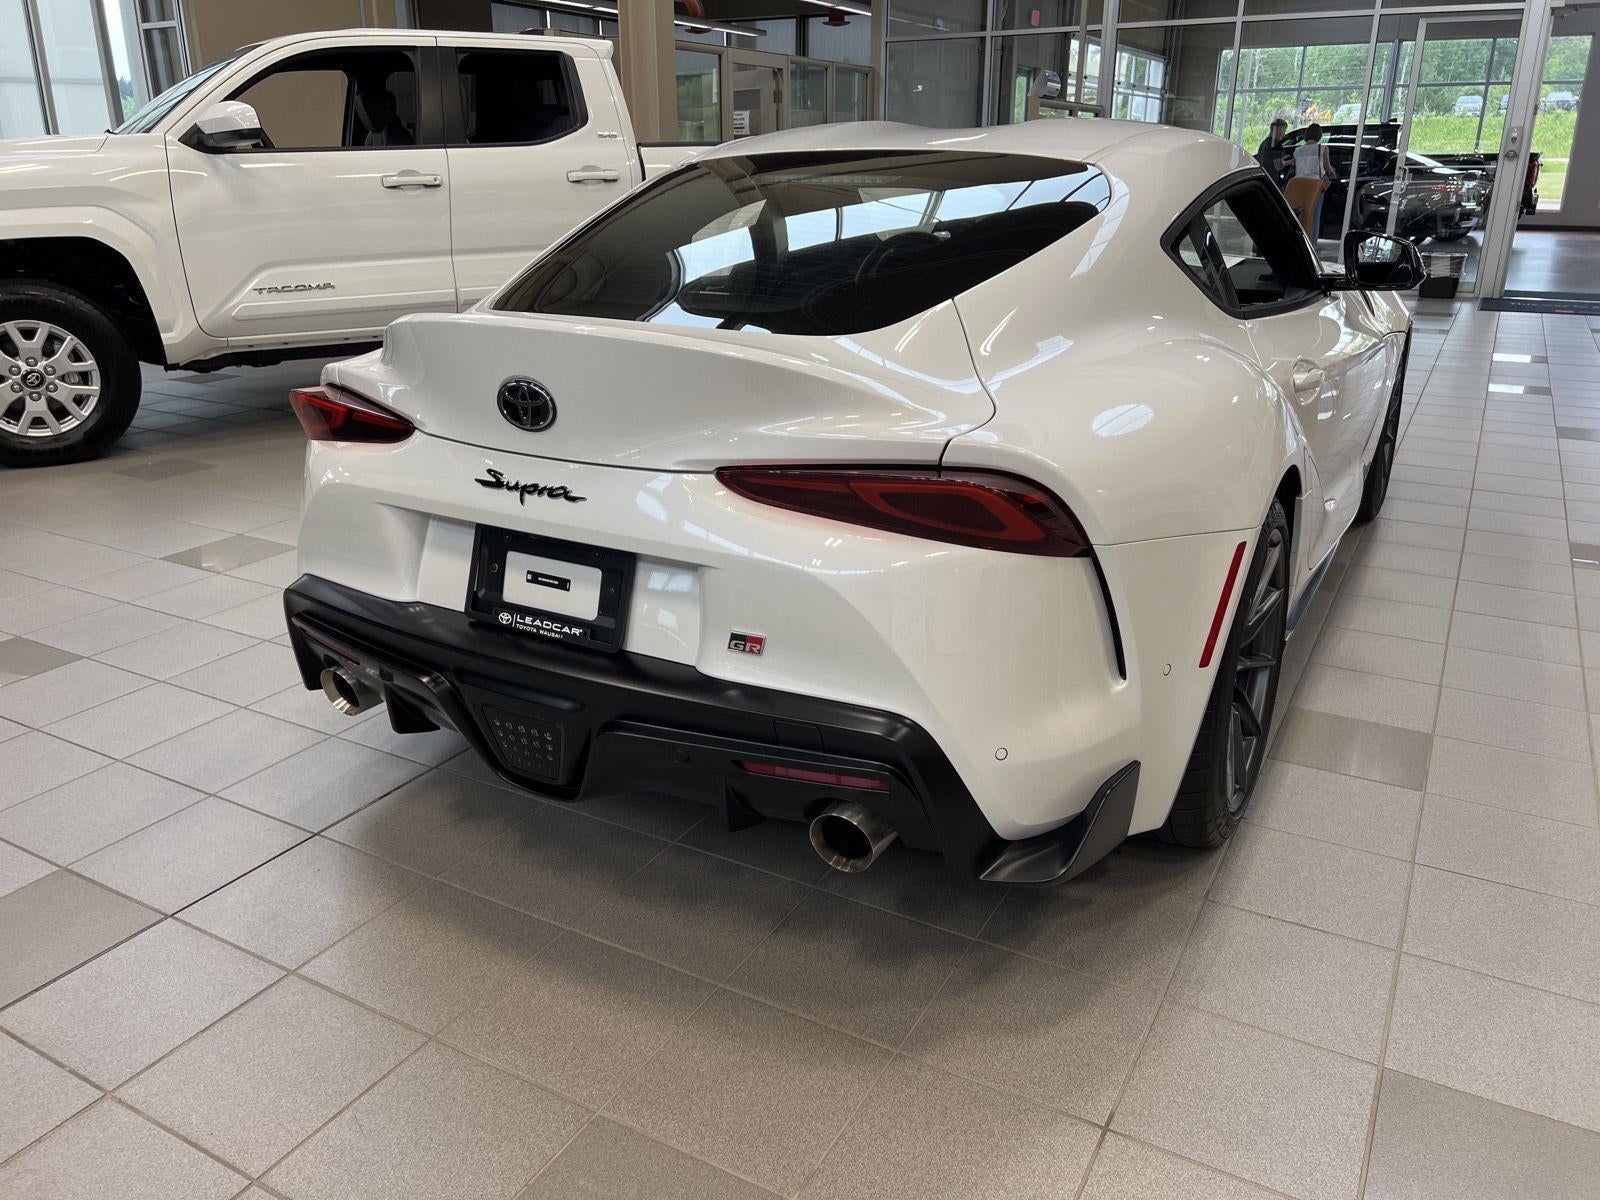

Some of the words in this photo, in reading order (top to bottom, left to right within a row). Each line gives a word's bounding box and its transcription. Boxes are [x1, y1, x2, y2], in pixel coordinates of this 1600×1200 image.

[252, 282, 335, 294] TACOMA
[474, 468, 587, 506] Supra
[515, 623, 537, 633] TOYOTA
[516, 614, 580, 636] LEADCAR
[729, 640, 762, 654] GR
